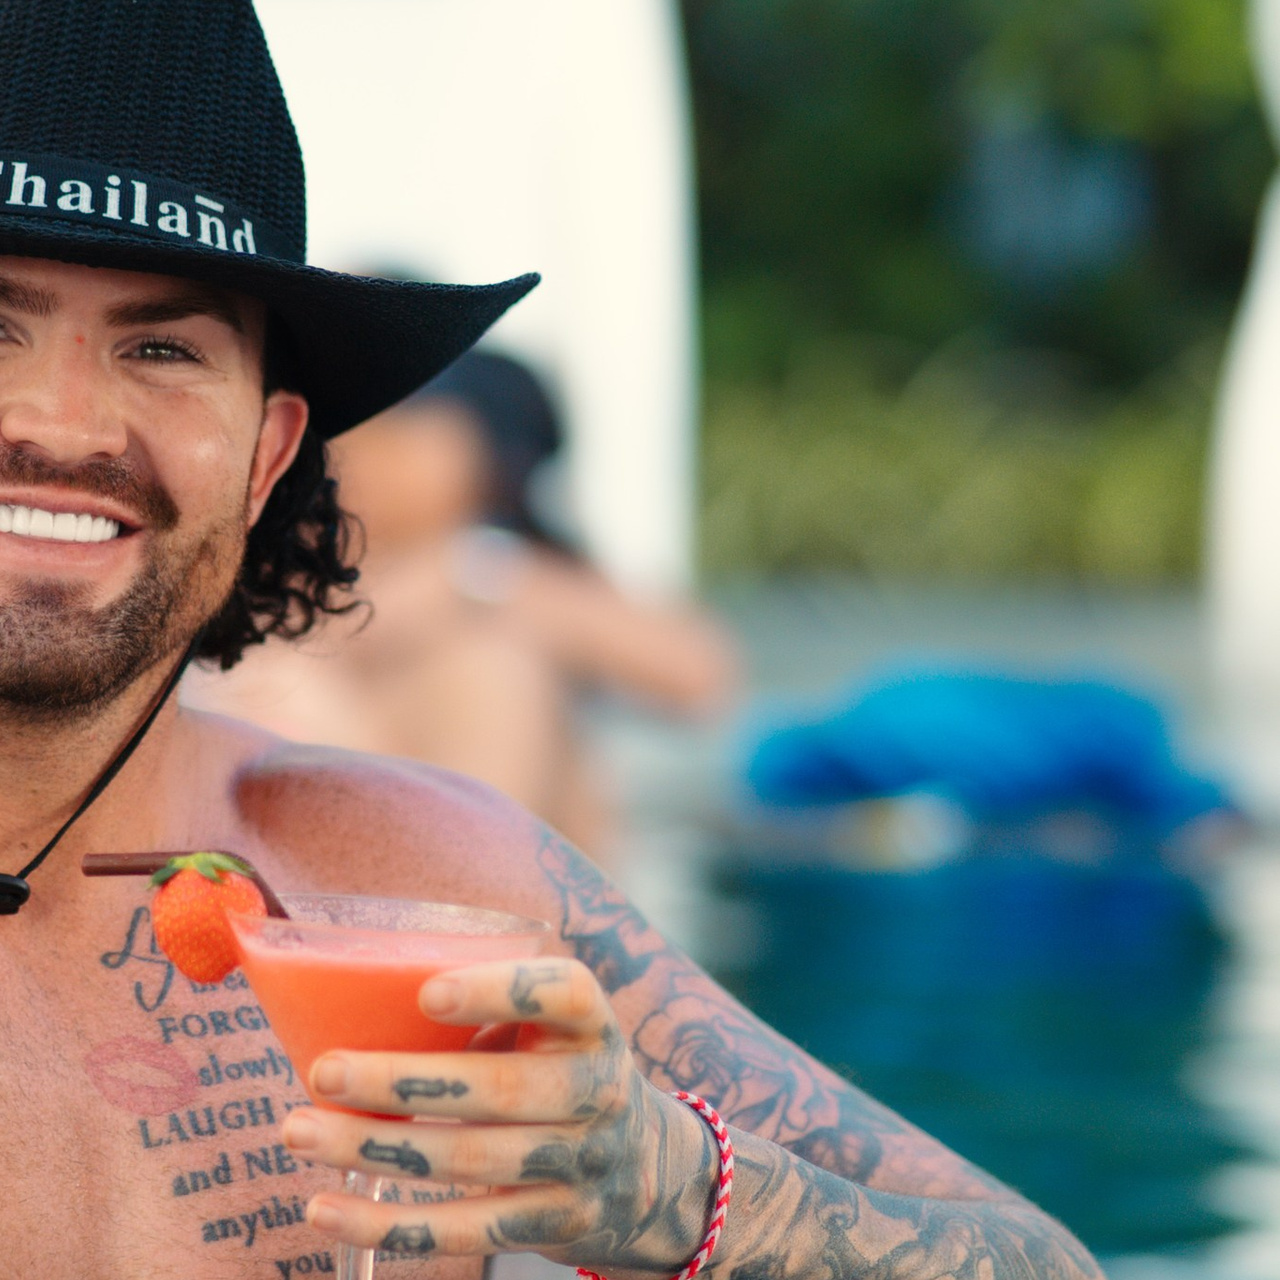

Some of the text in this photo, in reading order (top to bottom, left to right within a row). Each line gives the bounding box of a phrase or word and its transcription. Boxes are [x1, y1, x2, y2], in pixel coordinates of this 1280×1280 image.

[198, 1046, 294, 1086] slowly
[138, 1096, 276, 1150] LAUGH
[173, 1152, 234, 1197] and
[201, 1195, 307, 1248] anythi
